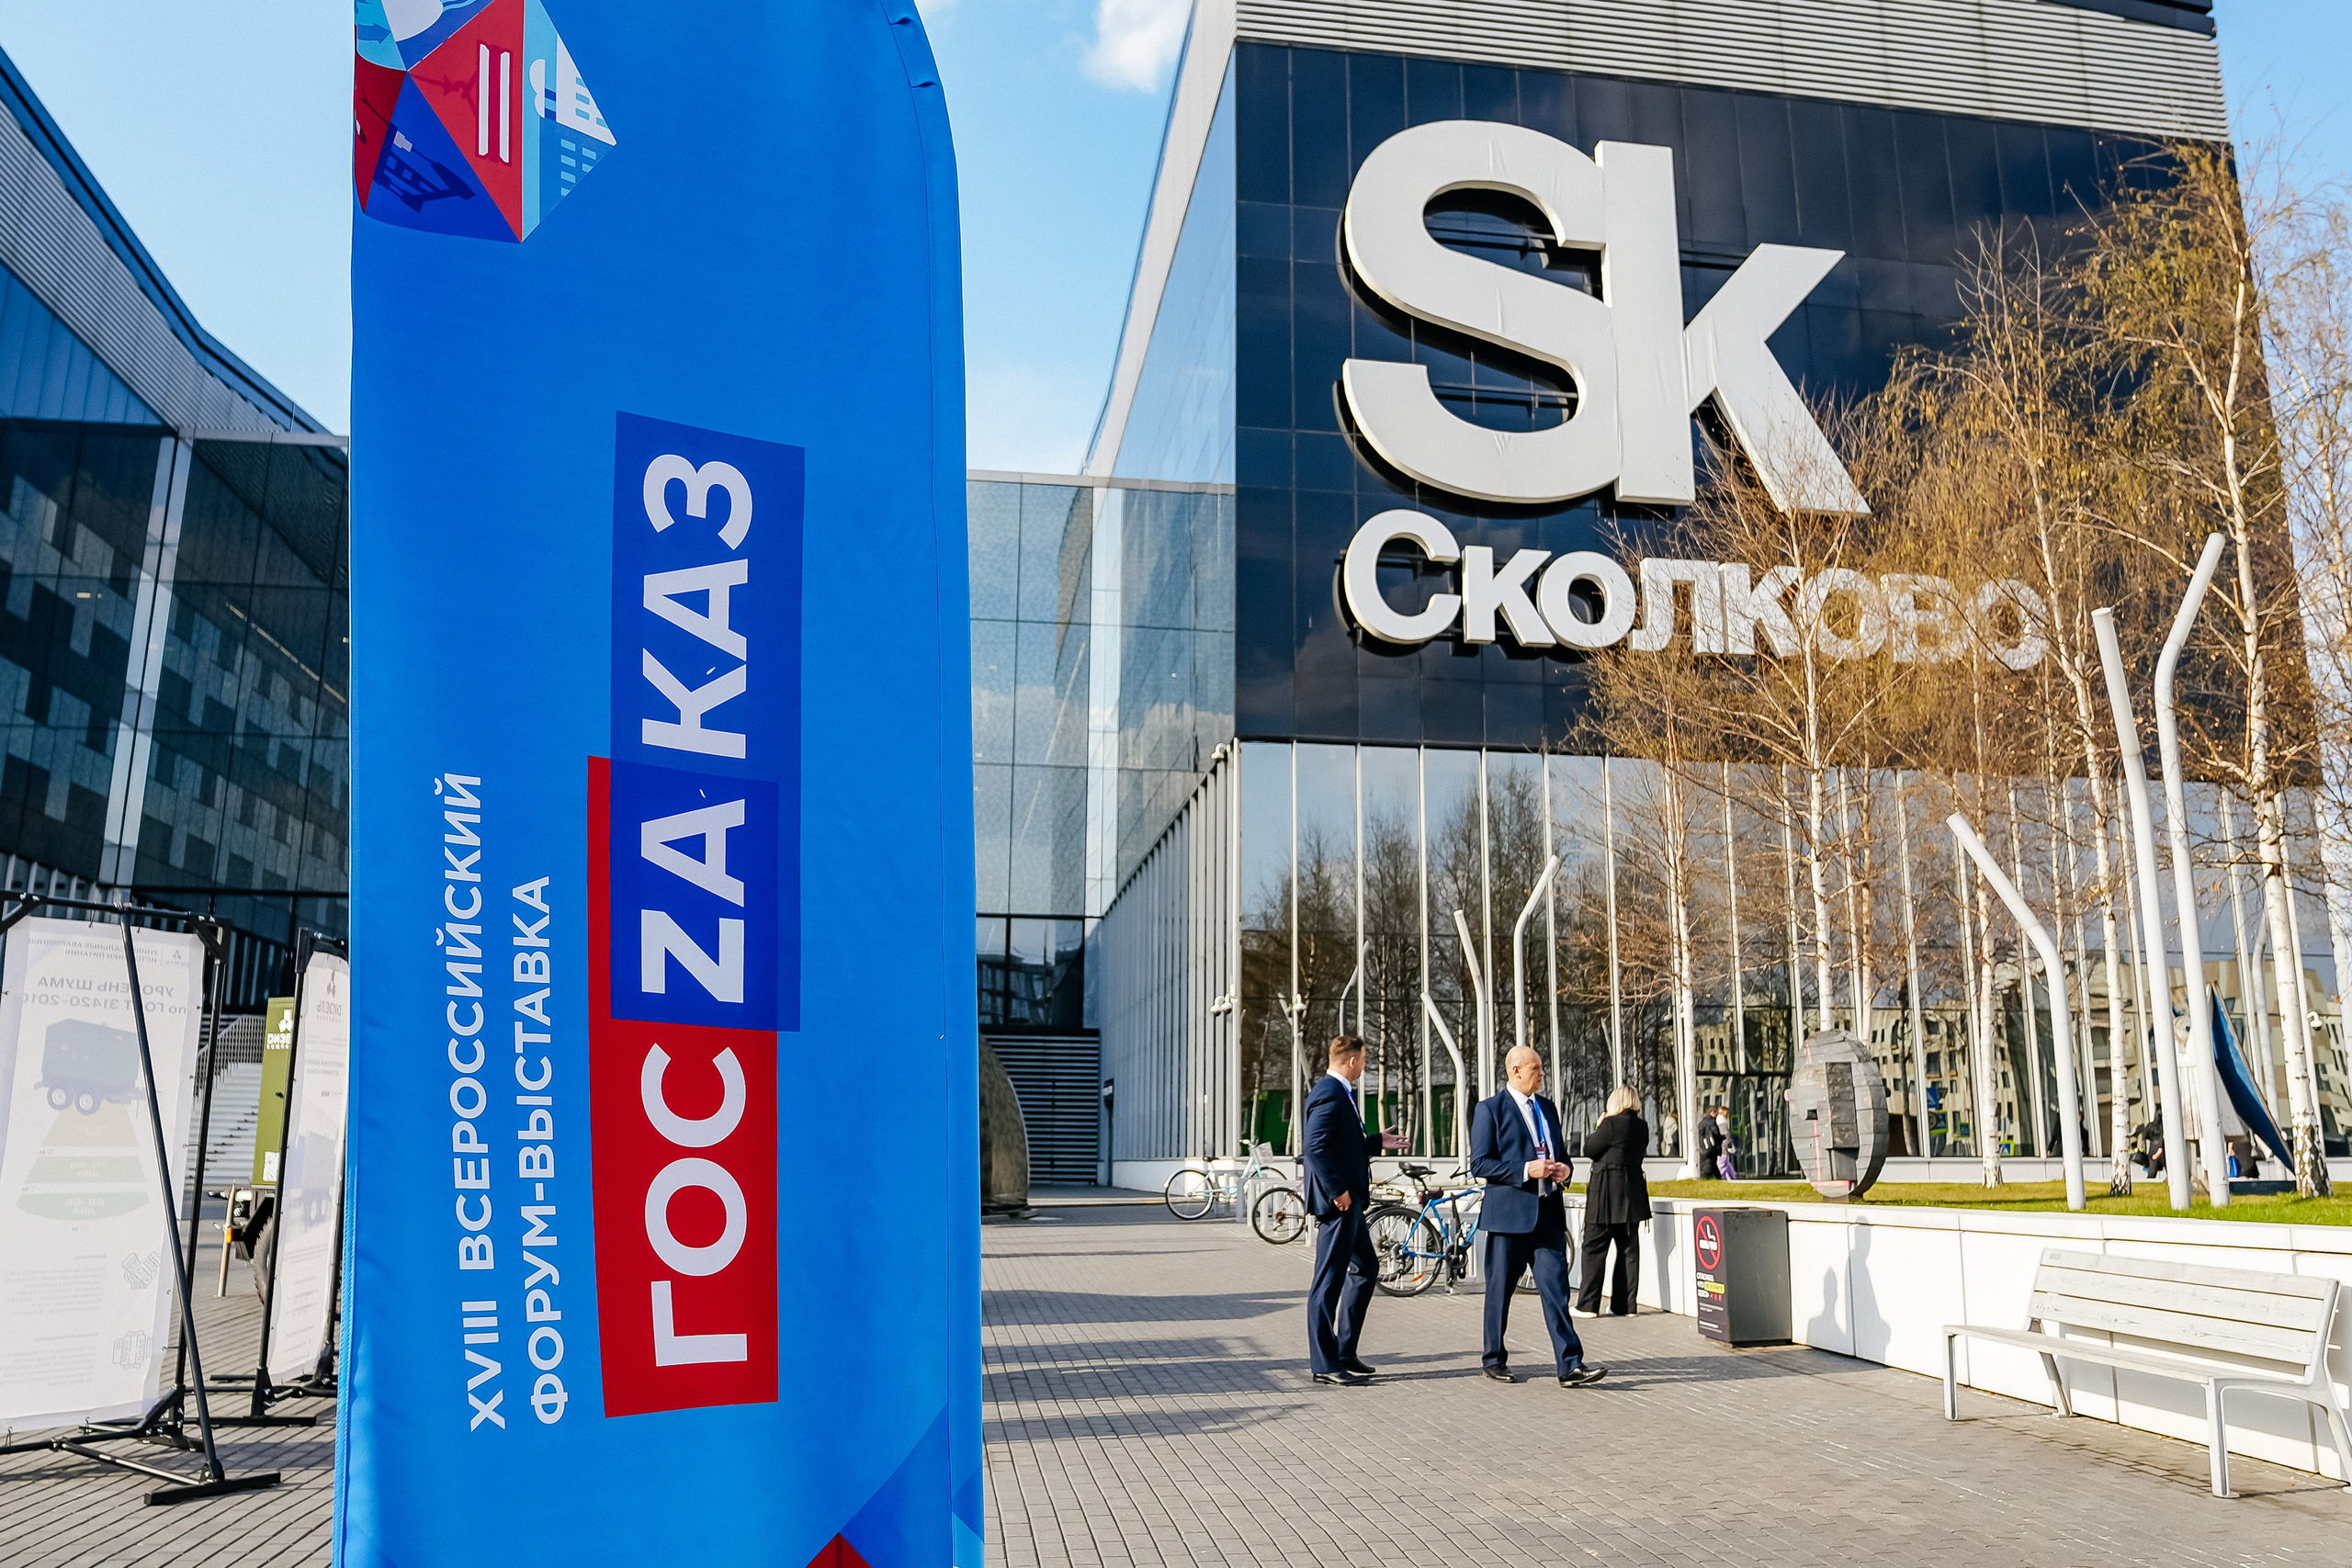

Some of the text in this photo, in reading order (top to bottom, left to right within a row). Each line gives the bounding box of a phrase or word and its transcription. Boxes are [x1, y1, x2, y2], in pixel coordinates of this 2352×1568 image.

[1342, 119, 1871, 516] Sk
[435, 772, 506, 1433] XVIII ВСЕРОССИЙСКИЙ
[512, 875, 568, 1426] ФОРУМ-ВЫСТАВКА
